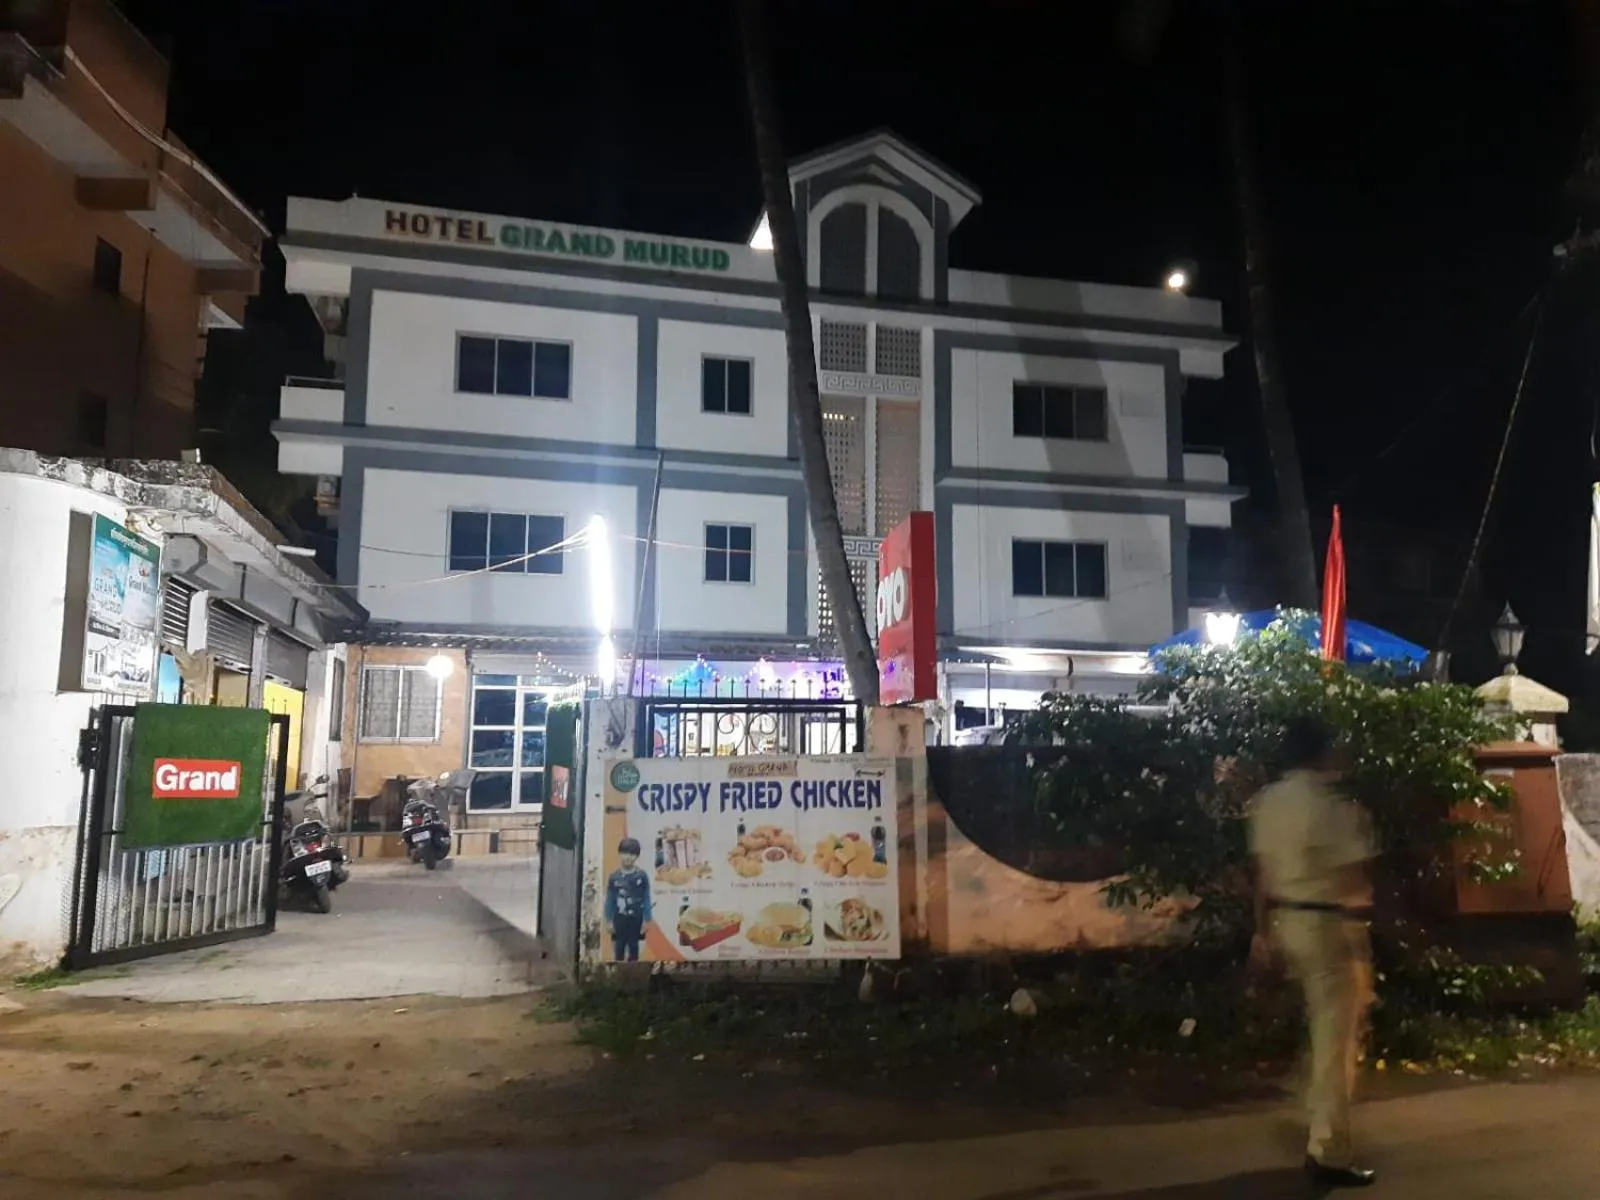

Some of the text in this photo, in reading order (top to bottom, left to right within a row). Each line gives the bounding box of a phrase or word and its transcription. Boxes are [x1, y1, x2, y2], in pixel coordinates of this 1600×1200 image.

[385, 209, 730, 271] HOTEL GRAND MURUD
[877, 565, 906, 634] OYO
[156, 763, 237, 791] Grand
[638, 779, 881, 814] CRISPY FRIED CHICKEN
